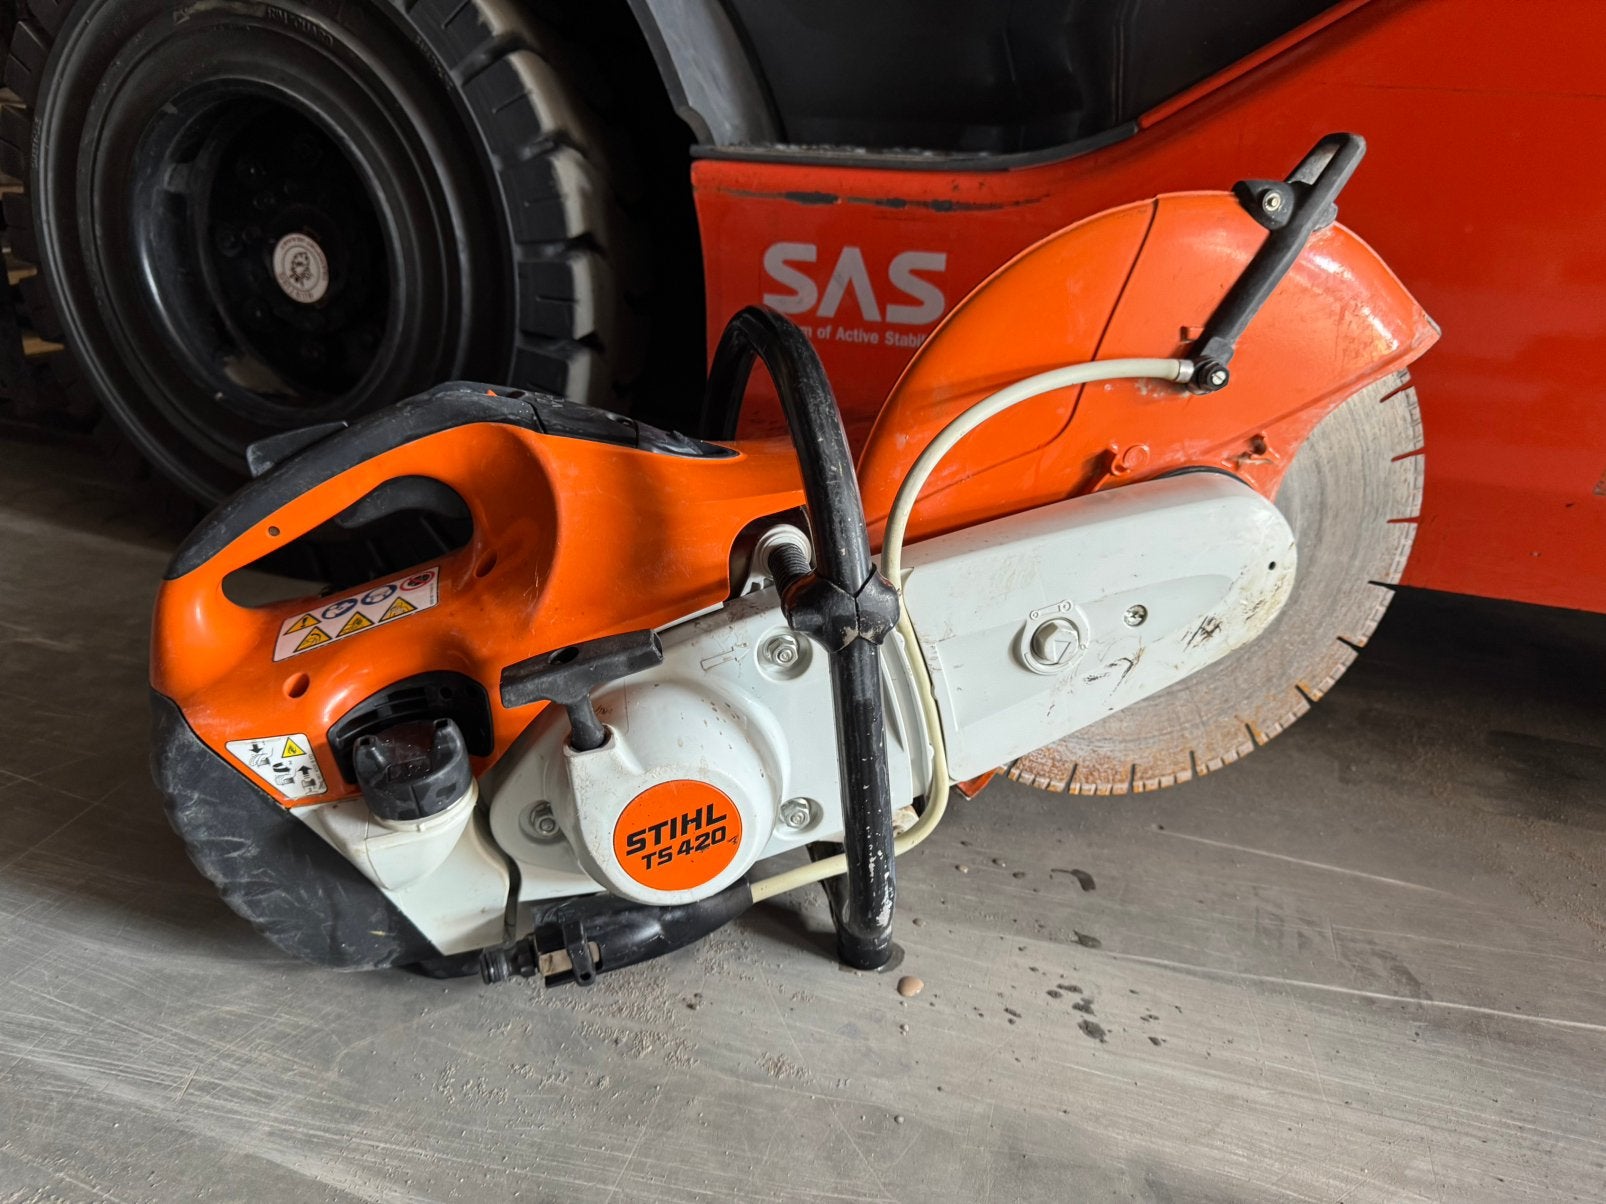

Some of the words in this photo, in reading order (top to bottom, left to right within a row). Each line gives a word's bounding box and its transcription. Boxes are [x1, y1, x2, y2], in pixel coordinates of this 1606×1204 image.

[763, 241, 947, 326] SAS
[817, 324, 832, 339] of
[835, 326, 879, 344] Active
[885, 330, 926, 347] Stabil
[626, 803, 727, 856] STIHL
[641, 845, 673, 870] TS
[677, 826, 726, 855] 420
